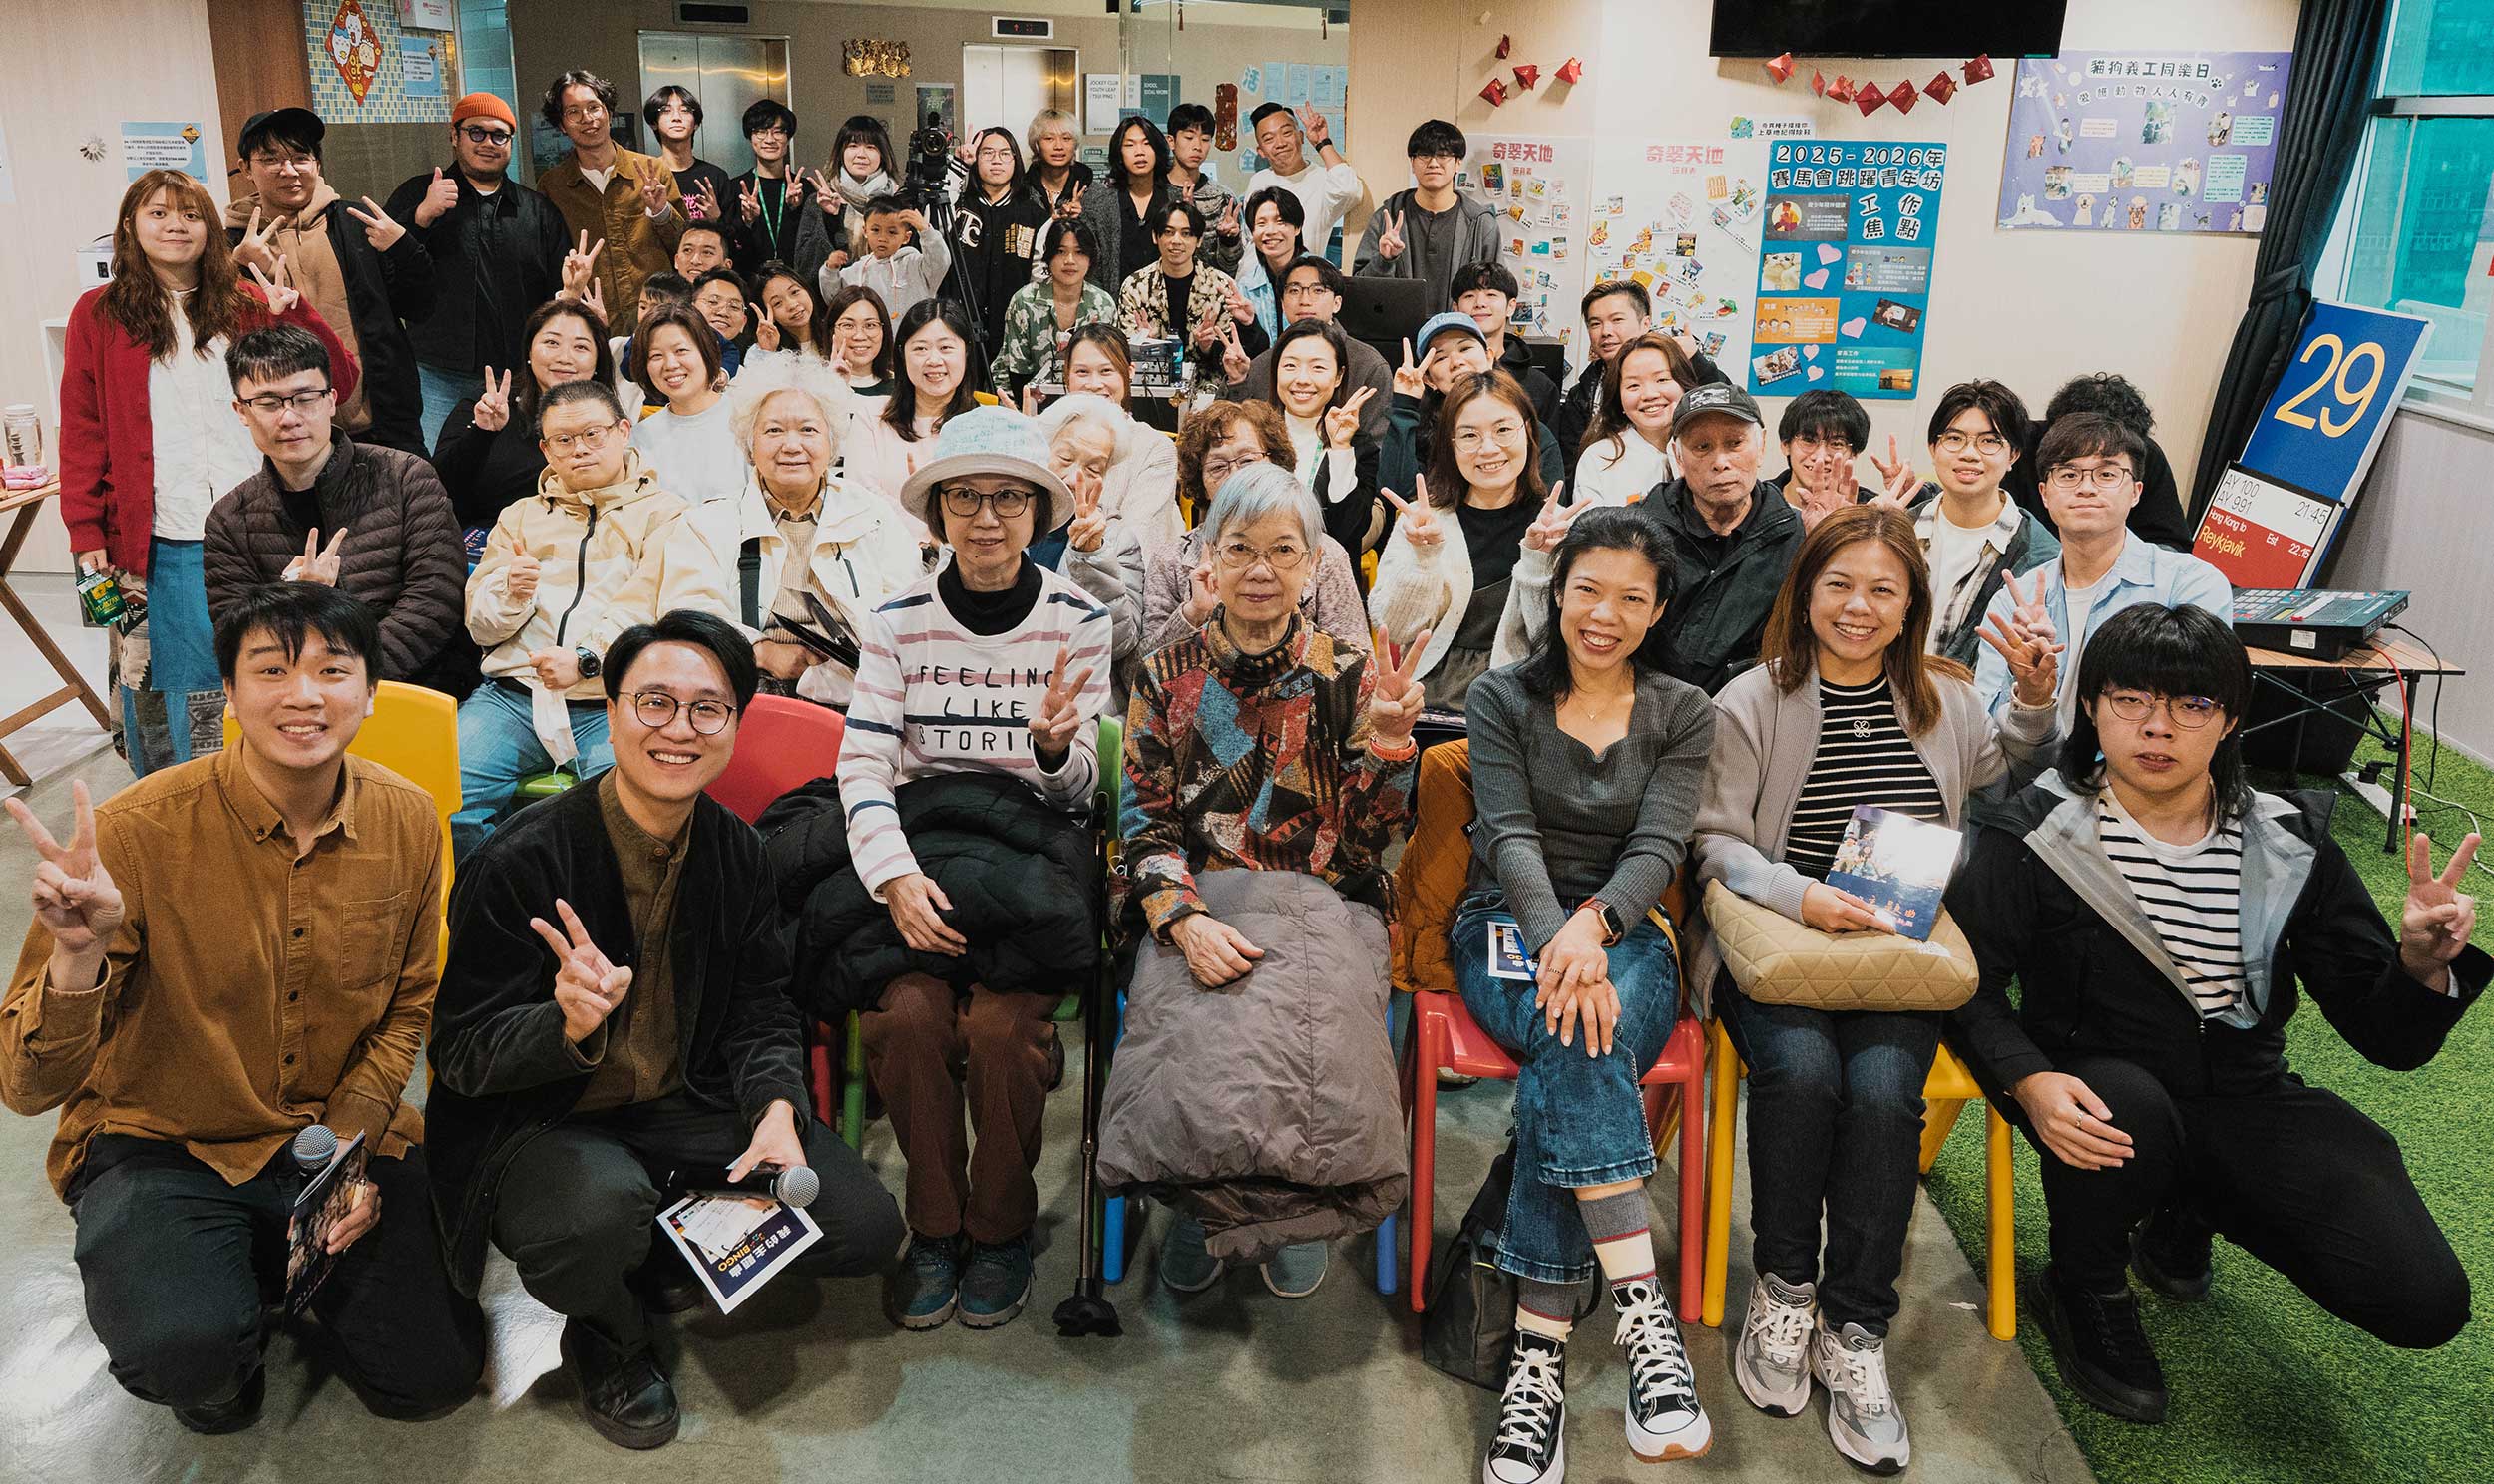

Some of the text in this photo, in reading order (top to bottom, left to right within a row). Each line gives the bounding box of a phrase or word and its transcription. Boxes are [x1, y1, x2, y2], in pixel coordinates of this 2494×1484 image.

[2091, 60, 2210, 78] 貓狗義工同樂日
[1772, 169, 1942, 190] 賽馬會跳躍青年坊
[2274, 333, 2385, 438] 29
[2223, 474, 2260, 498] AY 100
[2218, 490, 2252, 514] AY 991
[2208, 509, 2247, 532] Hong Kong to
[2198, 525, 2247, 557] Reykjavik
[2266, 533, 2279, 546] Est
[944, 697, 1026, 718] LIKE
[718, 1245, 751, 1271] BINGO
